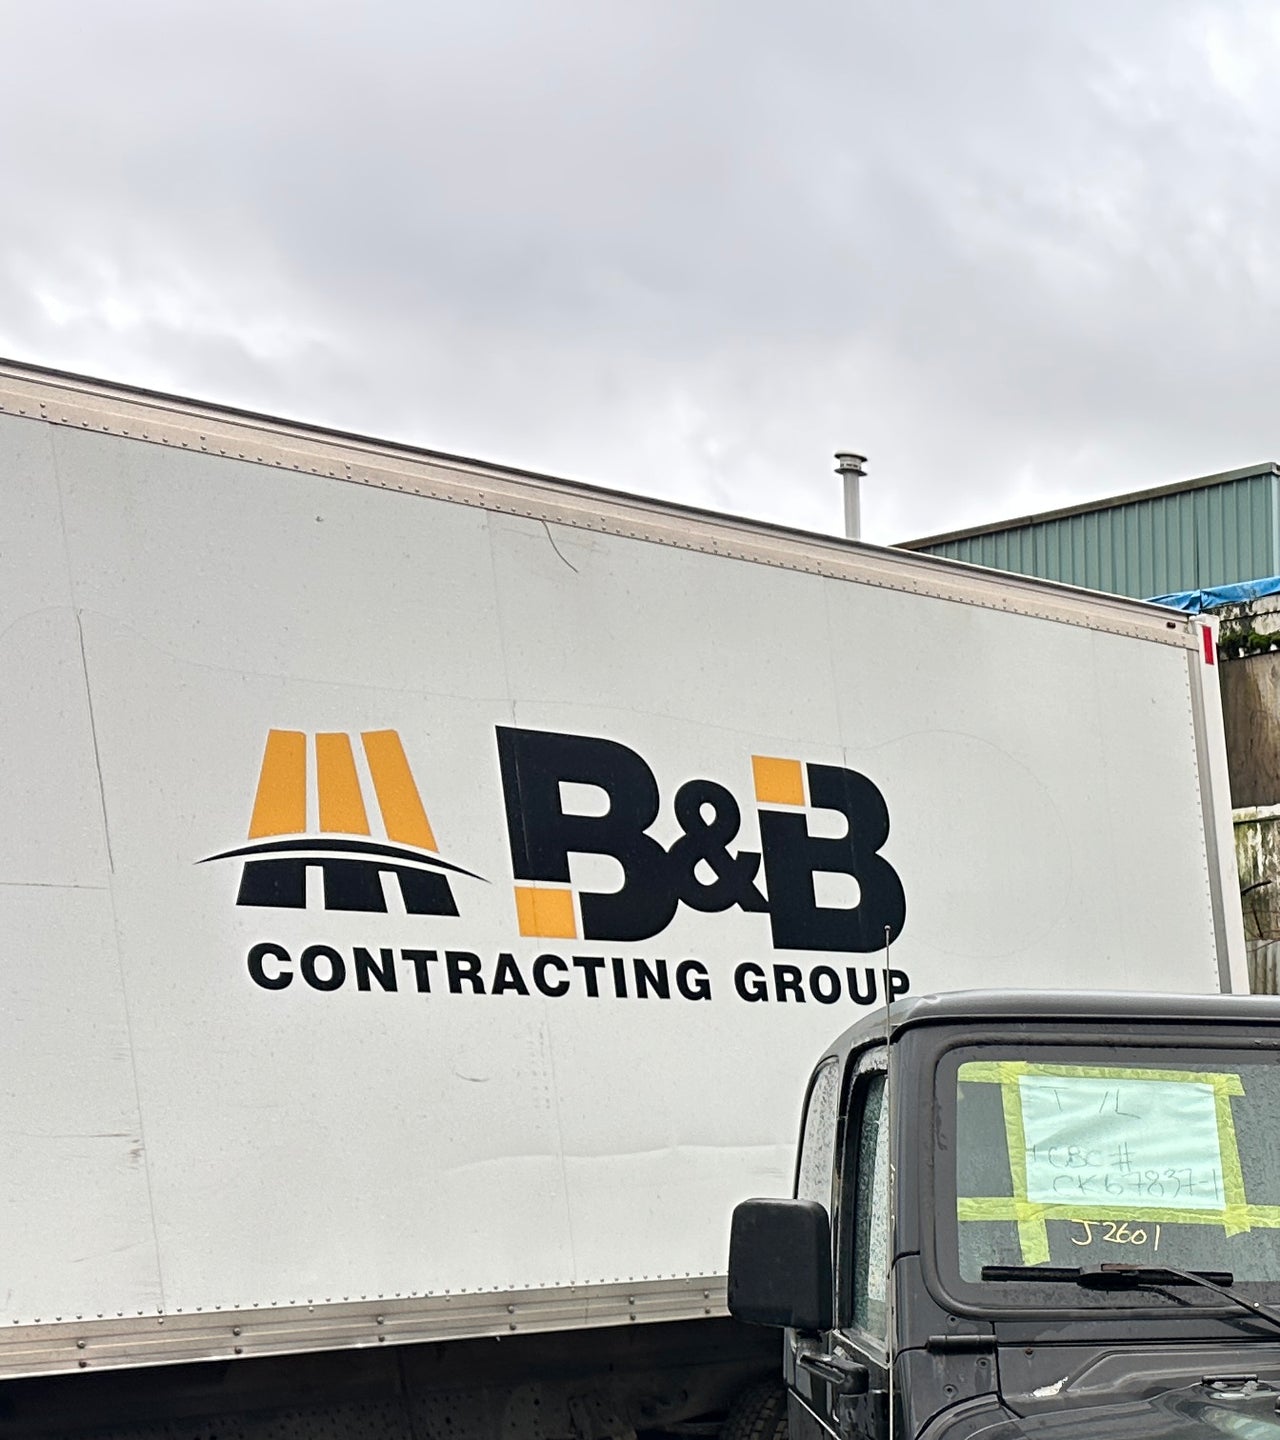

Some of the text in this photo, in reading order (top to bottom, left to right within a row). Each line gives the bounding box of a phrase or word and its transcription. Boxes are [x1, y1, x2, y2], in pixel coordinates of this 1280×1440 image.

[495, 725, 907, 953] B&B
[247, 942, 911, 1006] CONTRACTING GROUP
[1070, 1219, 1162, 1252] J2601
